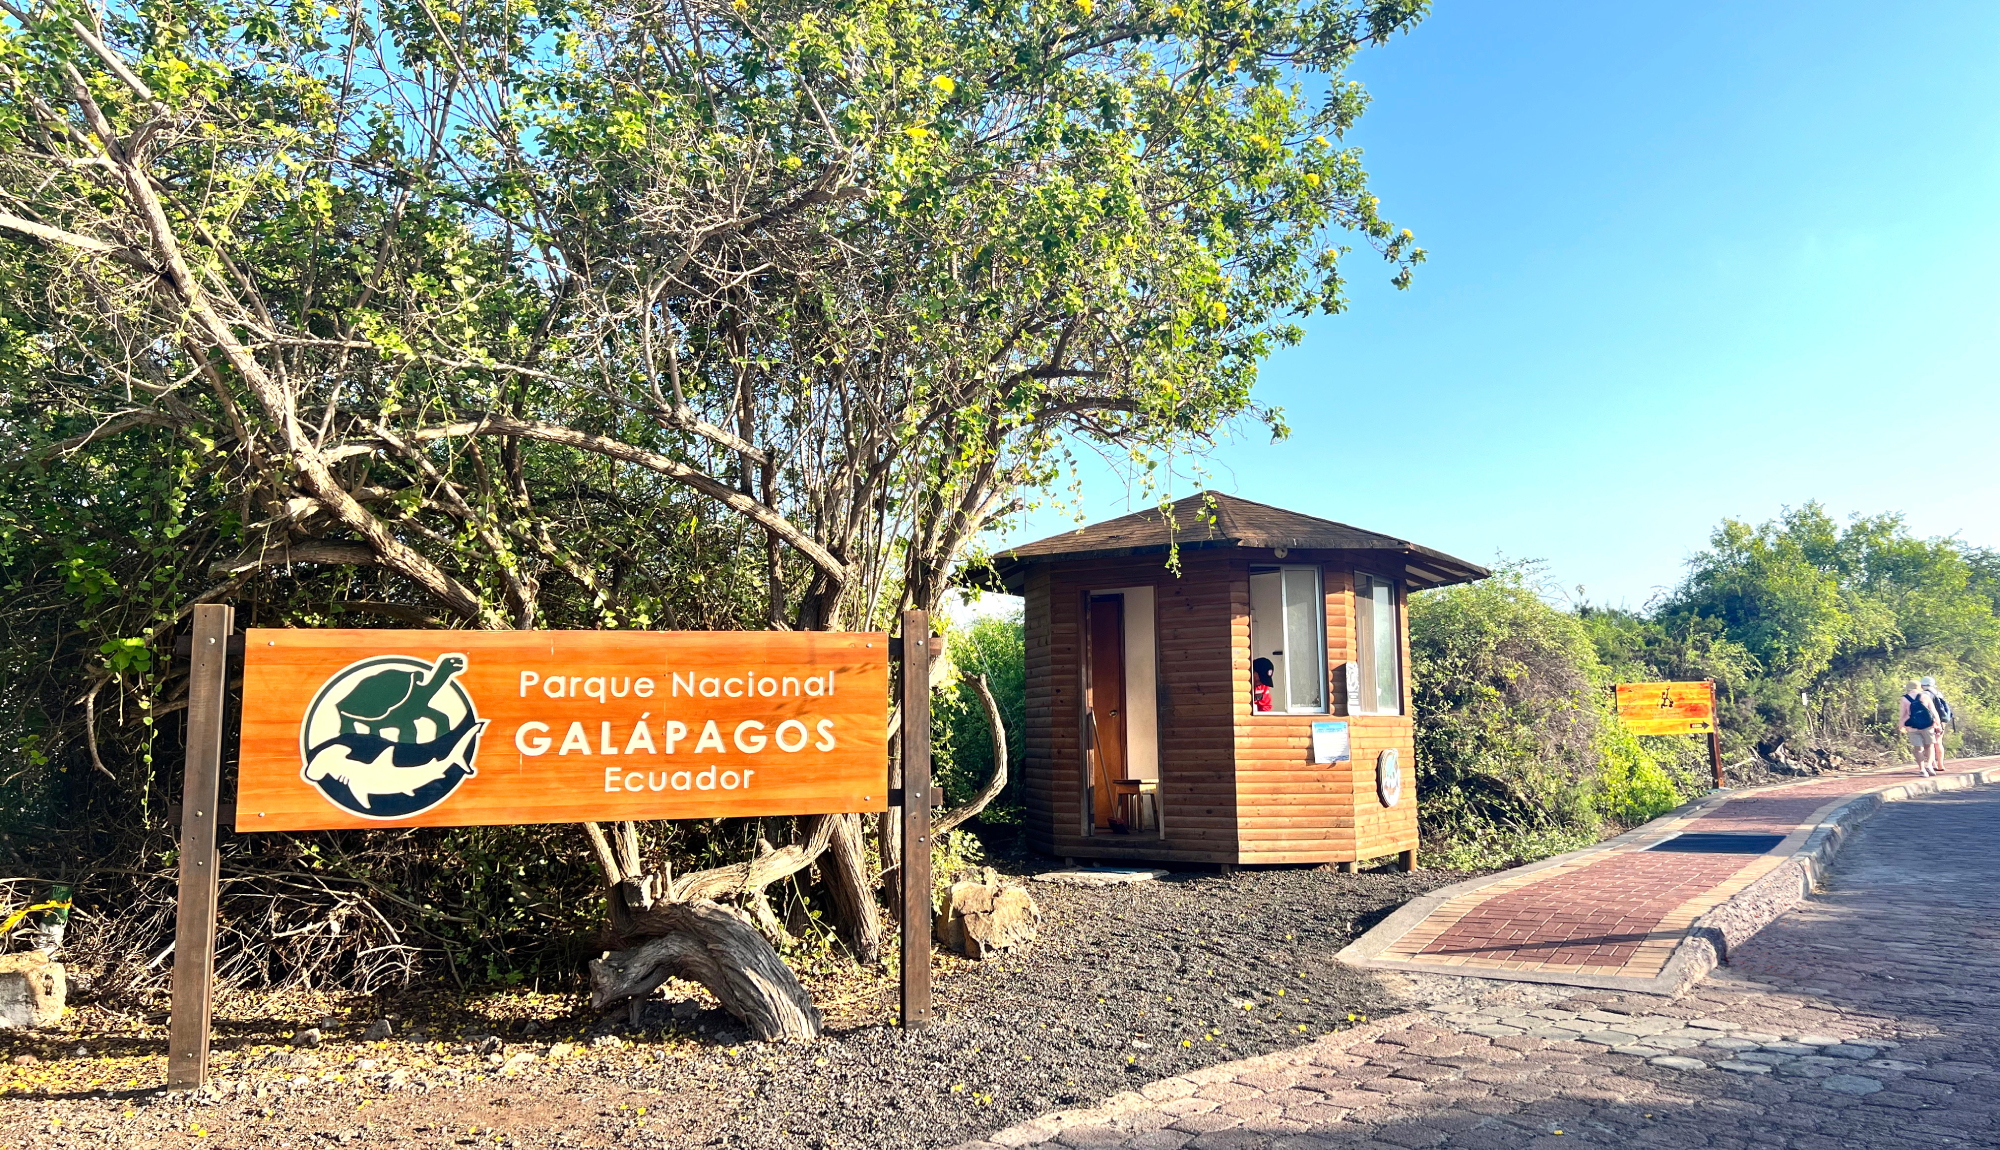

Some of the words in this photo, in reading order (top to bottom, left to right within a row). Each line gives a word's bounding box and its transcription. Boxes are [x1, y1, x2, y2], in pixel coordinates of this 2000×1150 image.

[519, 670, 656, 704] Parque
[672, 670, 836, 698] Nacional
[514, 711, 837, 757] GALÁPAGOS
[604, 764, 755, 793] Ecuador
